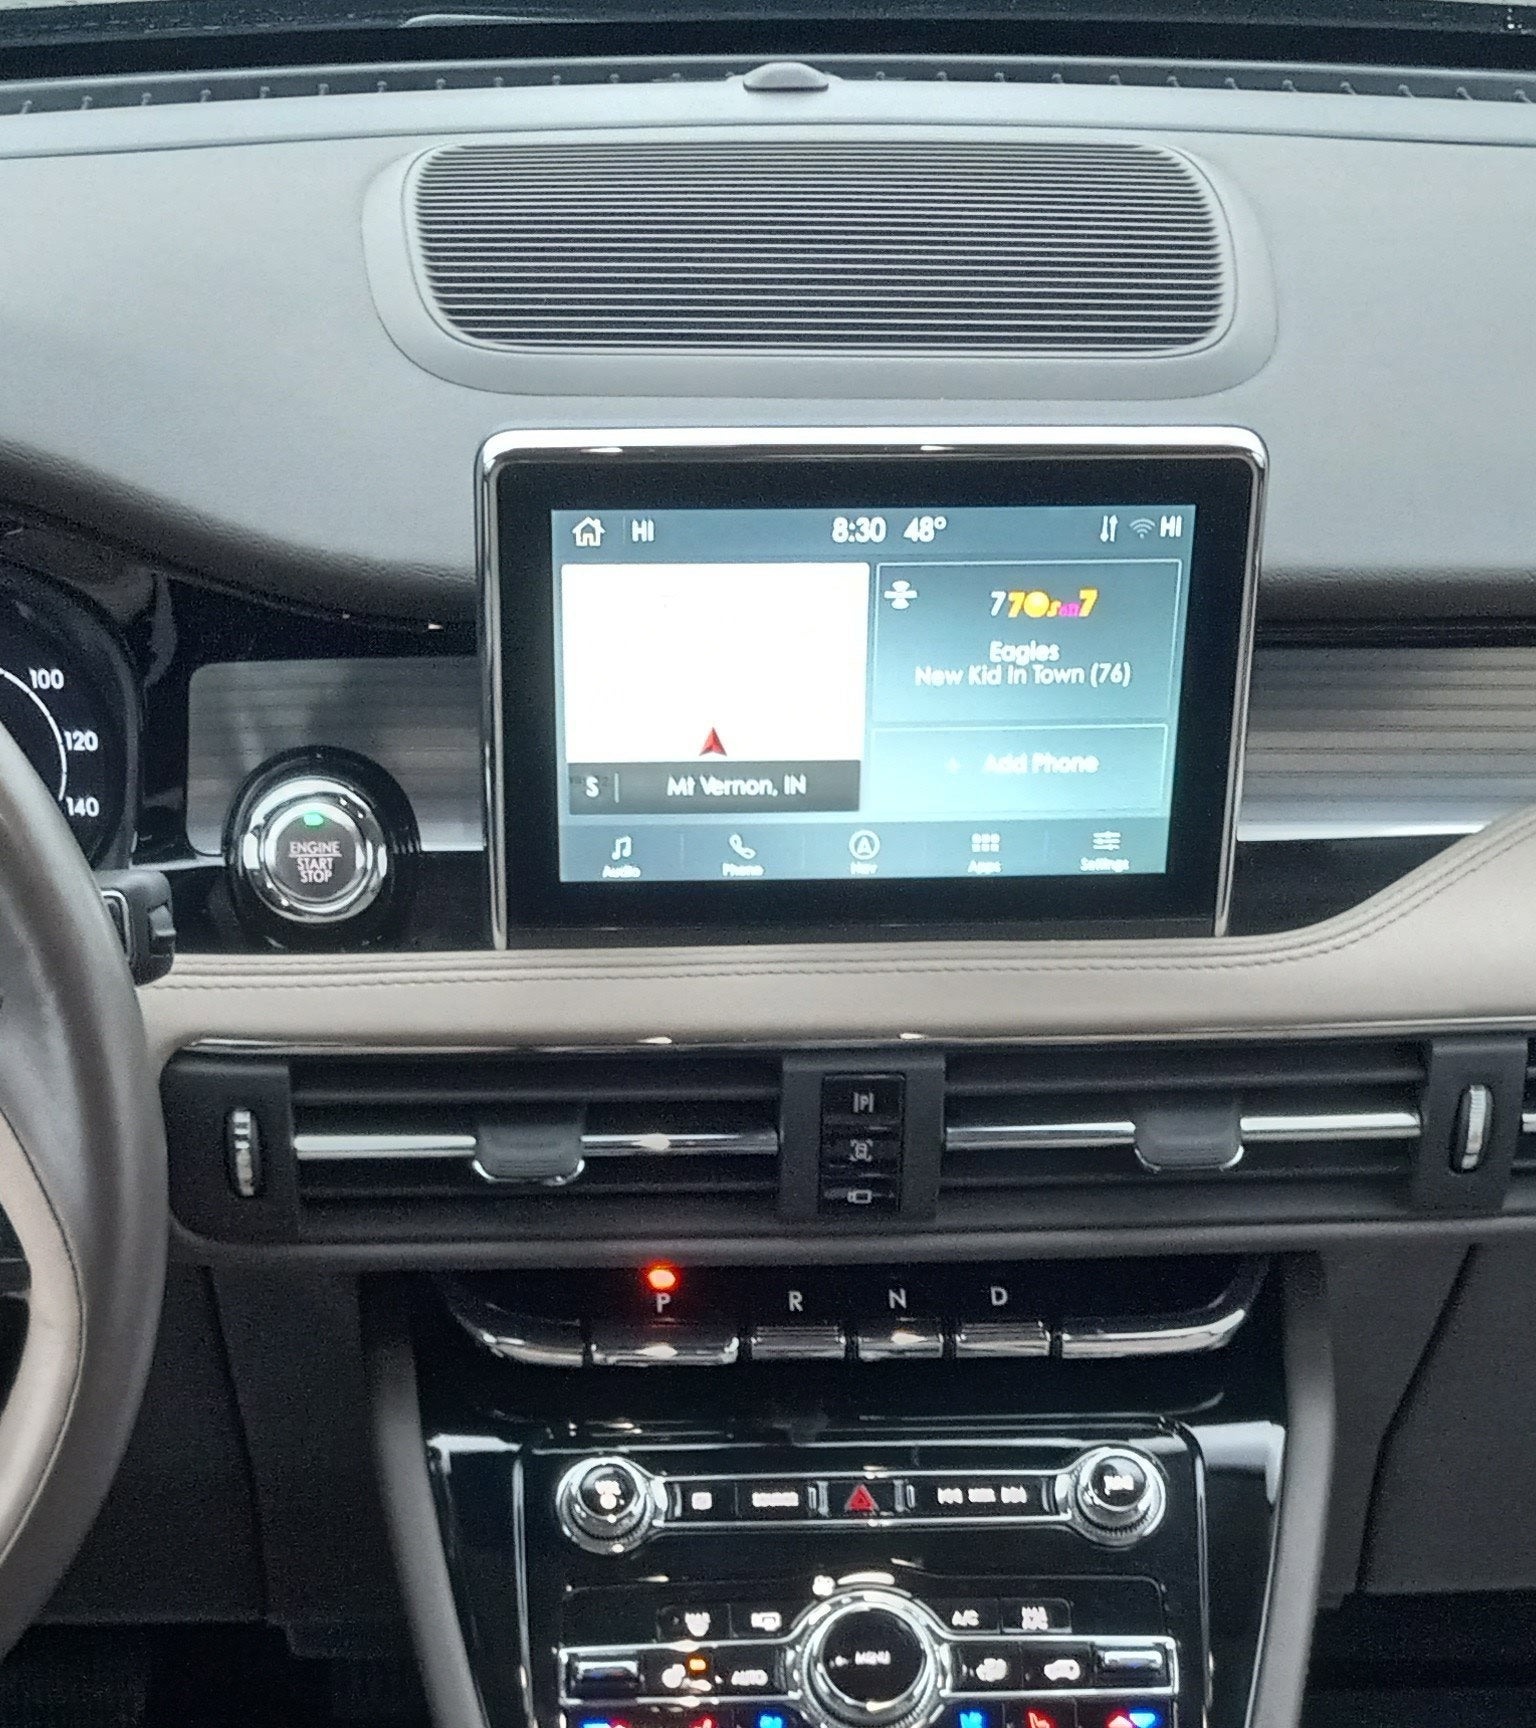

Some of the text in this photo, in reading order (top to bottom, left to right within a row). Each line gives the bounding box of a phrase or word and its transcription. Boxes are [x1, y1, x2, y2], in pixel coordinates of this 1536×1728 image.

[632, 517, 655, 543] HI
[831, 516, 887, 544] 8:30
[1159, 514, 1183, 538] HI
[989, 639, 1061, 666] Eagles
[29, 668, 64, 690] 100
[915, 664, 964, 688] New
[968, 664, 1003, 686] Kid
[1031, 662, 1085, 685] Town
[1090, 661, 1132, 688] (76)
[64, 731, 98, 752] 120
[983, 751, 1100, 775] Add Phone
[586, 774, 807, 799] S Mt Vernon, IN
[65, 796, 99, 818] 140
[289, 840, 341, 854] ENGINE
[296, 857, 333, 871] START
[300, 870, 332, 884] STOP
[655, 1286, 1009, 1313] P R N D
